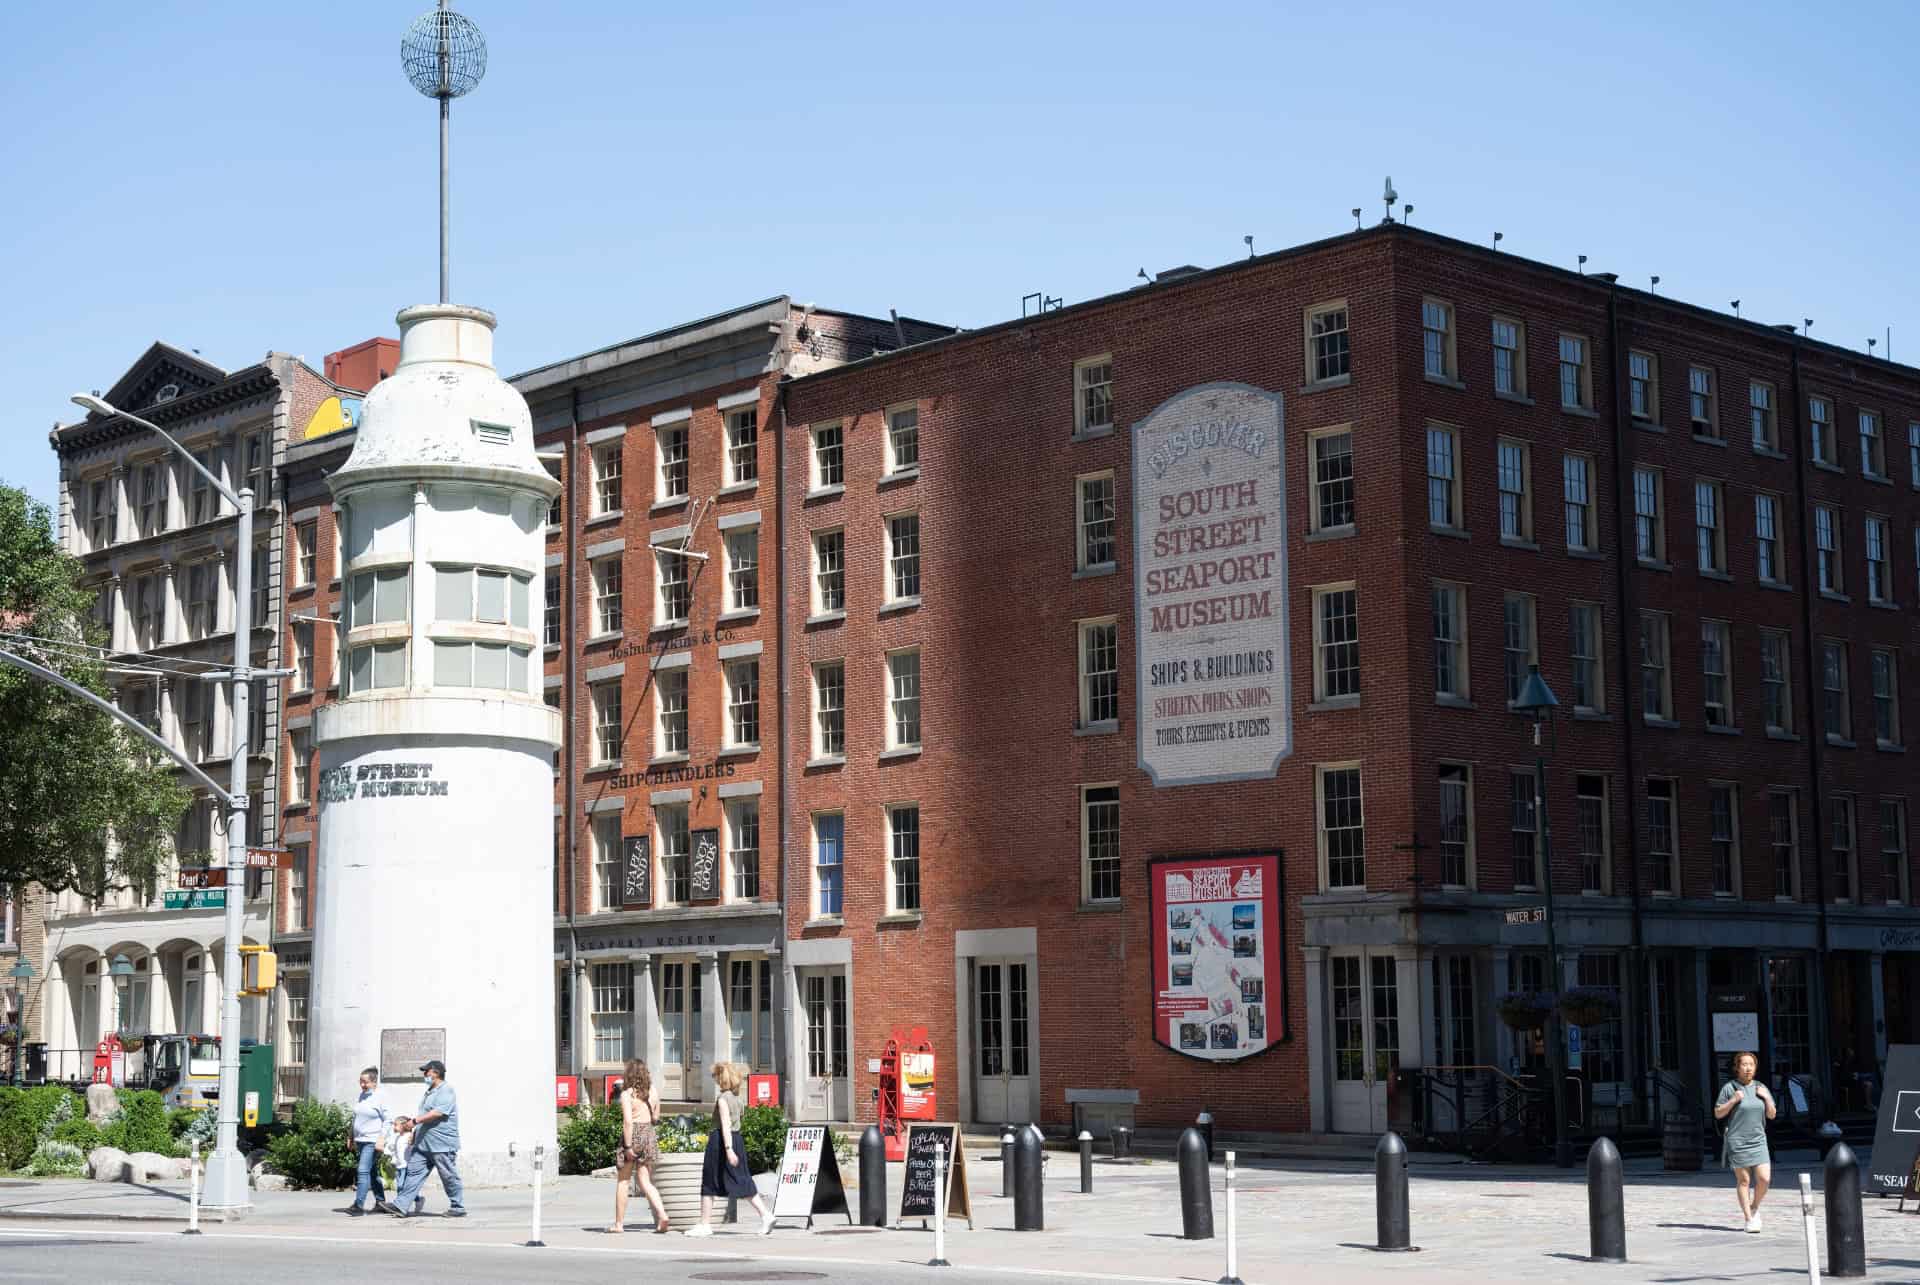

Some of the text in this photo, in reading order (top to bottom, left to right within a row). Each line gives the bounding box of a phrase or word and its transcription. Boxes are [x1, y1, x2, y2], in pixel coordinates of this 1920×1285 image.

[1148, 421, 1265, 479] DISCOVER
[1159, 479, 1258, 523] SOUTH
[1154, 516, 1266, 557] STREET
[1146, 552, 1275, 596] SEAPORT
[1151, 591, 1272, 632] MUSEUM
[1151, 649, 1272, 686] SHIPS & BUILDINGS
[1236, 687, 1271, 709] SHOPS
[1186, 721, 1226, 743] EXHIBITS
[1228, 721, 1235, 739] &
[1237, 717, 1270, 738] EVENTS
[357, 763, 432, 781] STREET
[361, 781, 448, 798] MUSEUM
[270, 854, 278, 866] St
[636, 858, 648, 893] AND
[1193, 886, 1232, 900] MUSEUM
[1504, 910, 1543, 924] WATER ST
[656, 935, 716, 947] MUSEUM
[789, 1129, 823, 1140] SEAPORT
[792, 1140, 813, 1152] HOUSE
[782, 1173, 818, 1184] FRONT ST
